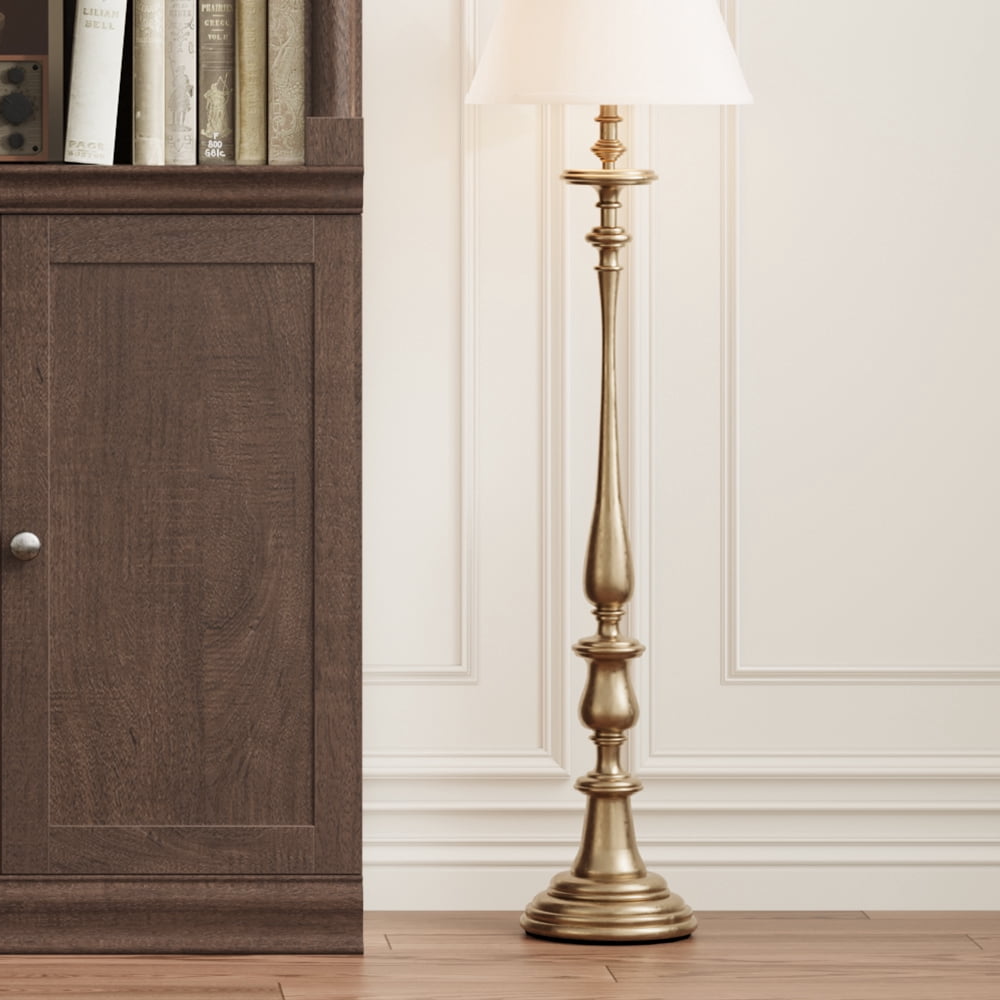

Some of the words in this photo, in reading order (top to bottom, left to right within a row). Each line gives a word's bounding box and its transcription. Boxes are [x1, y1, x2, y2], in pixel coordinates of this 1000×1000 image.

[82, 7, 120, 18] LILIAN
[84, 19, 116, 30] BELL
[207, 140, 223, 149] 800
